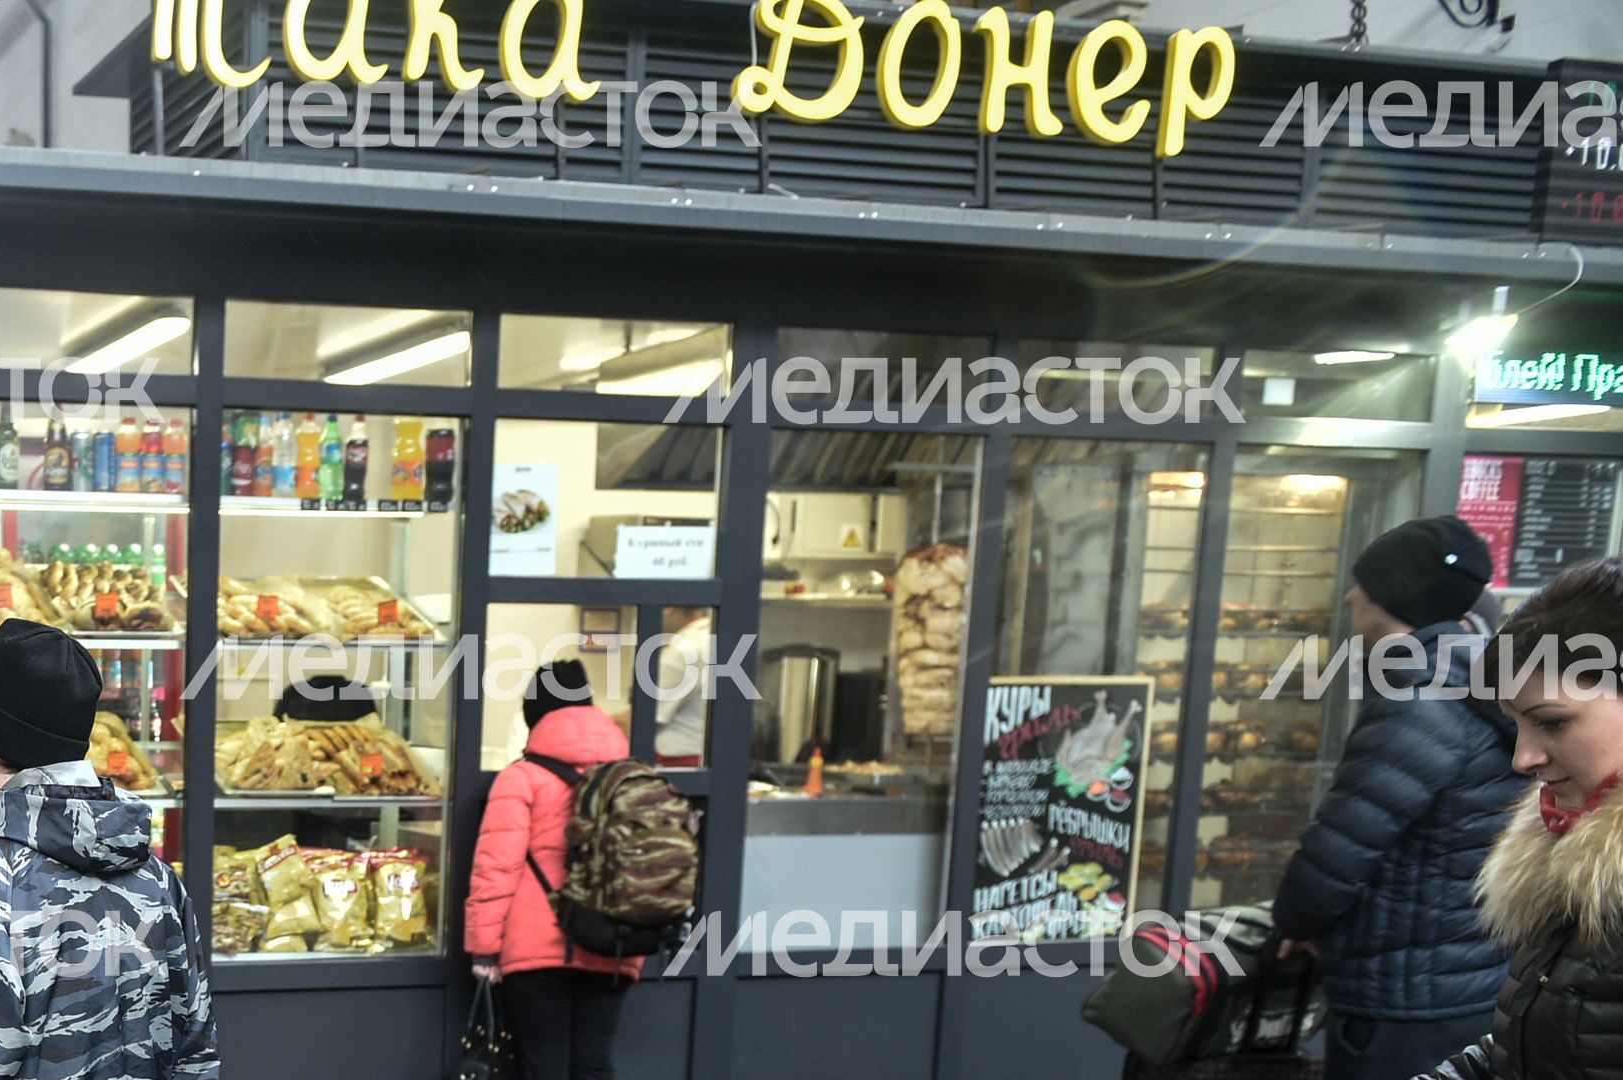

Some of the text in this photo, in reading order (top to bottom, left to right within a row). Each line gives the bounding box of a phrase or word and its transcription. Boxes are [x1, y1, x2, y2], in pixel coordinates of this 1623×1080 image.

[984, 685, 1052, 746] КУРЫ
[1047, 799, 1131, 853] РЁБРЫШКИ
[973, 869, 1059, 913] НАГЕТСЫ
